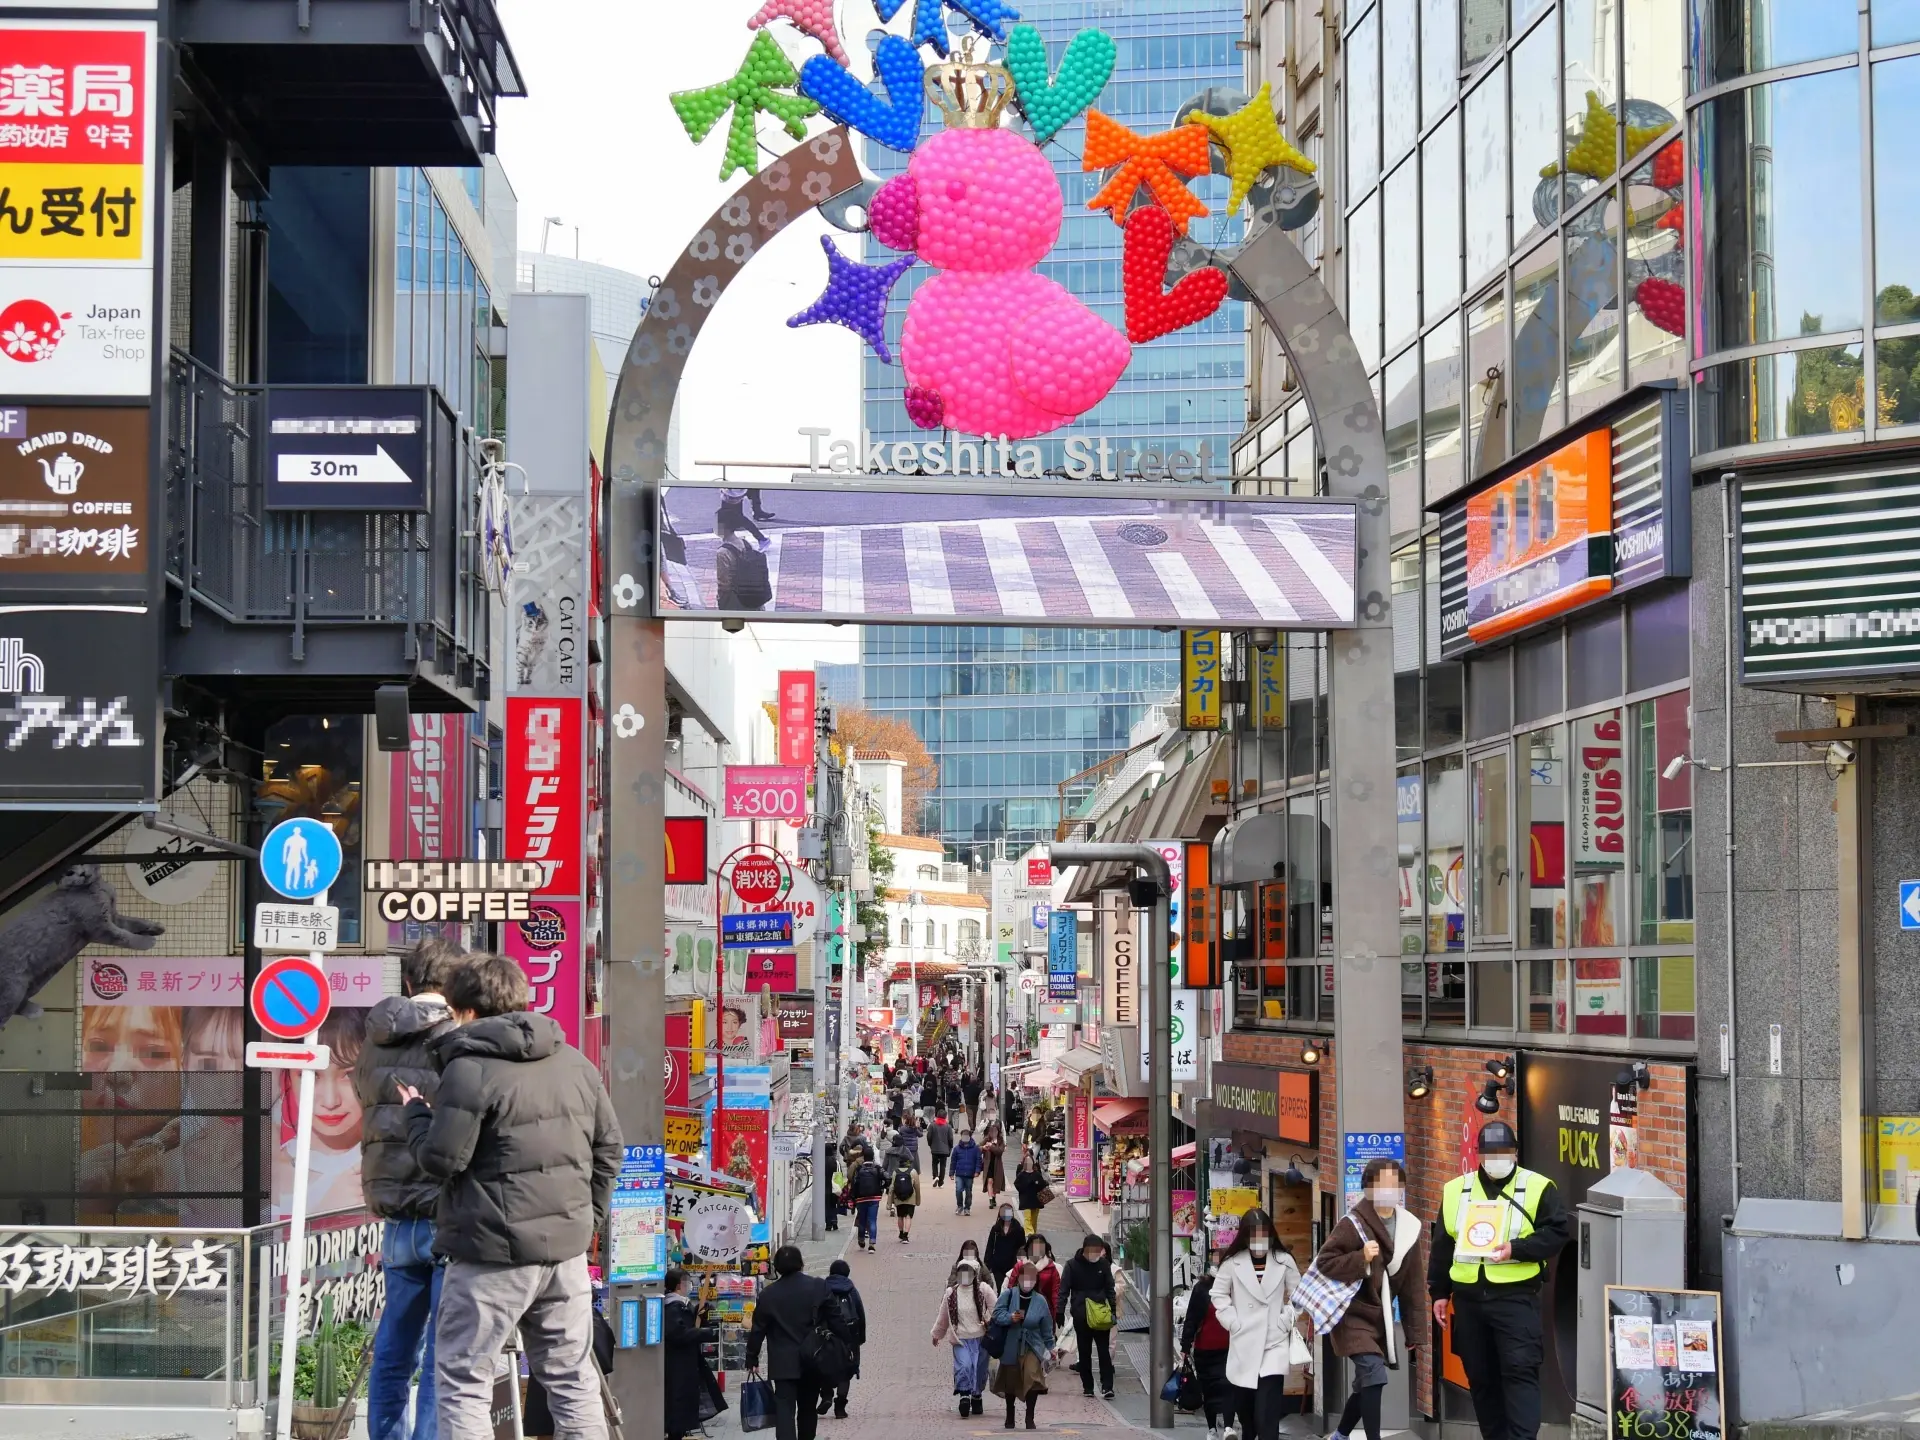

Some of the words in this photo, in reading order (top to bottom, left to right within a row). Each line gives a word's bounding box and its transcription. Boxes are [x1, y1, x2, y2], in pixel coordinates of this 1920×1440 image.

[1, 64, 134, 118] 薬局
[86, 124, 133, 150] 약국
[86, 303, 141, 323] Japan
[79, 324, 146, 341] Tax-free
[102, 344, 146, 362] Shop
[17, 431, 67, 457] HAND
[72, 432, 113, 455] DRIP
[798, 426, 1043, 479] Takeshita
[1063, 435, 1217, 484] Street
[310, 460, 358, 477] 30m
[73, 501, 132, 515] COFFEE
[558, 596, 575, 632] CAT
[559, 638, 574, 684] CAFE
[732, 788, 797, 814] ¥300
[735, 869, 778, 890] 消火栓
[383, 892, 529, 921] COFFEE
[260, 910, 333, 928] 自転車を除く
[264, 928, 280, 944] 11
[312, 929, 327, 946] 18
[1058, 916, 1067, 971] コインロッカー
[1049, 974, 1075, 983] MONEY
[1115, 940, 1131, 1022] COFFEE
[776, 1009, 813, 1019] アクセサリー
[783, 1020, 809, 1028] 日本一
[1216, 1083, 1256, 1114] WOLFGANG
[1256, 1089, 1277, 1117] PUCK
[1280, 1095, 1308, 1120] EXPRESS
[1558, 1104, 1600, 1126] WOLFGANG
[1558, 1127, 1600, 1170] PUCK
[697, 1203, 740, 1215] CATCAFE
[734, 1224, 748, 1235] 2F
[320, 1228, 355, 1266] DRIP
[698, 1244, 740, 1258] 猫カフェ
[1616, 1409, 1691, 1439] ¥638
